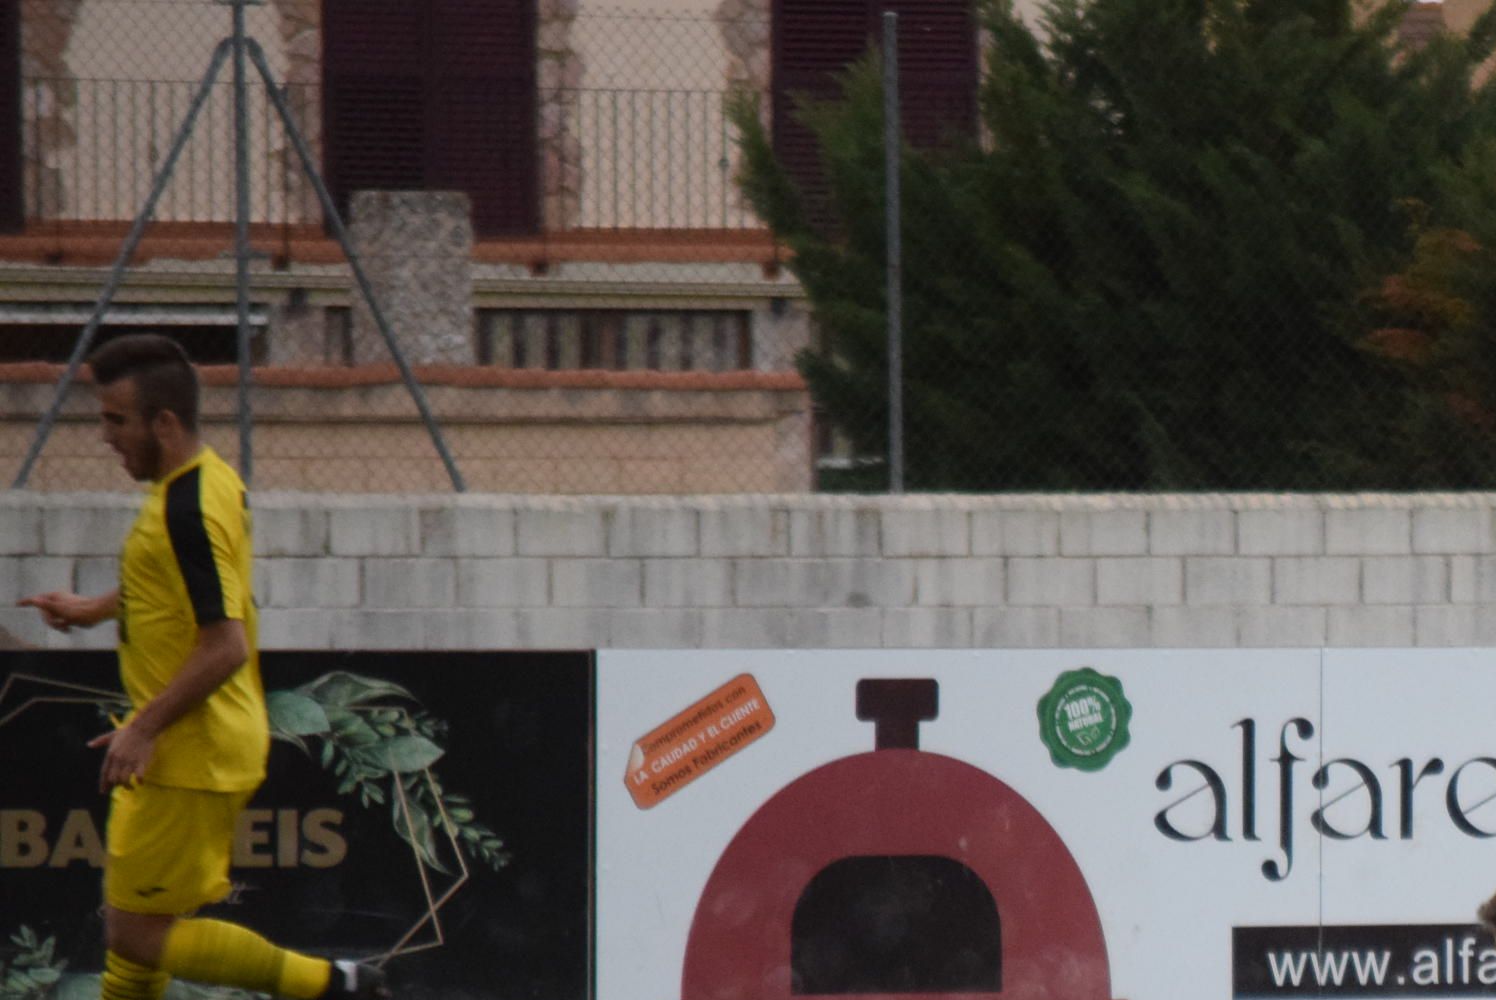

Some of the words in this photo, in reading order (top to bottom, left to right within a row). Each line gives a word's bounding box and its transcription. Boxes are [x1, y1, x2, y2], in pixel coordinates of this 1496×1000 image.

[726, 686, 746, 704] con
[1064, 696, 1101, 719] 100%
[633, 770, 648, 785] LA
[651, 738, 698, 773] CALIDAD
[696, 732, 706, 743] Y
[706, 725, 720, 738] EL
[720, 698, 760, 729] CLIENTE
[651, 765, 692, 795] Somos
[692, 720, 762, 768] Fabricantes
[0, 808, 347, 869] BAEIS
